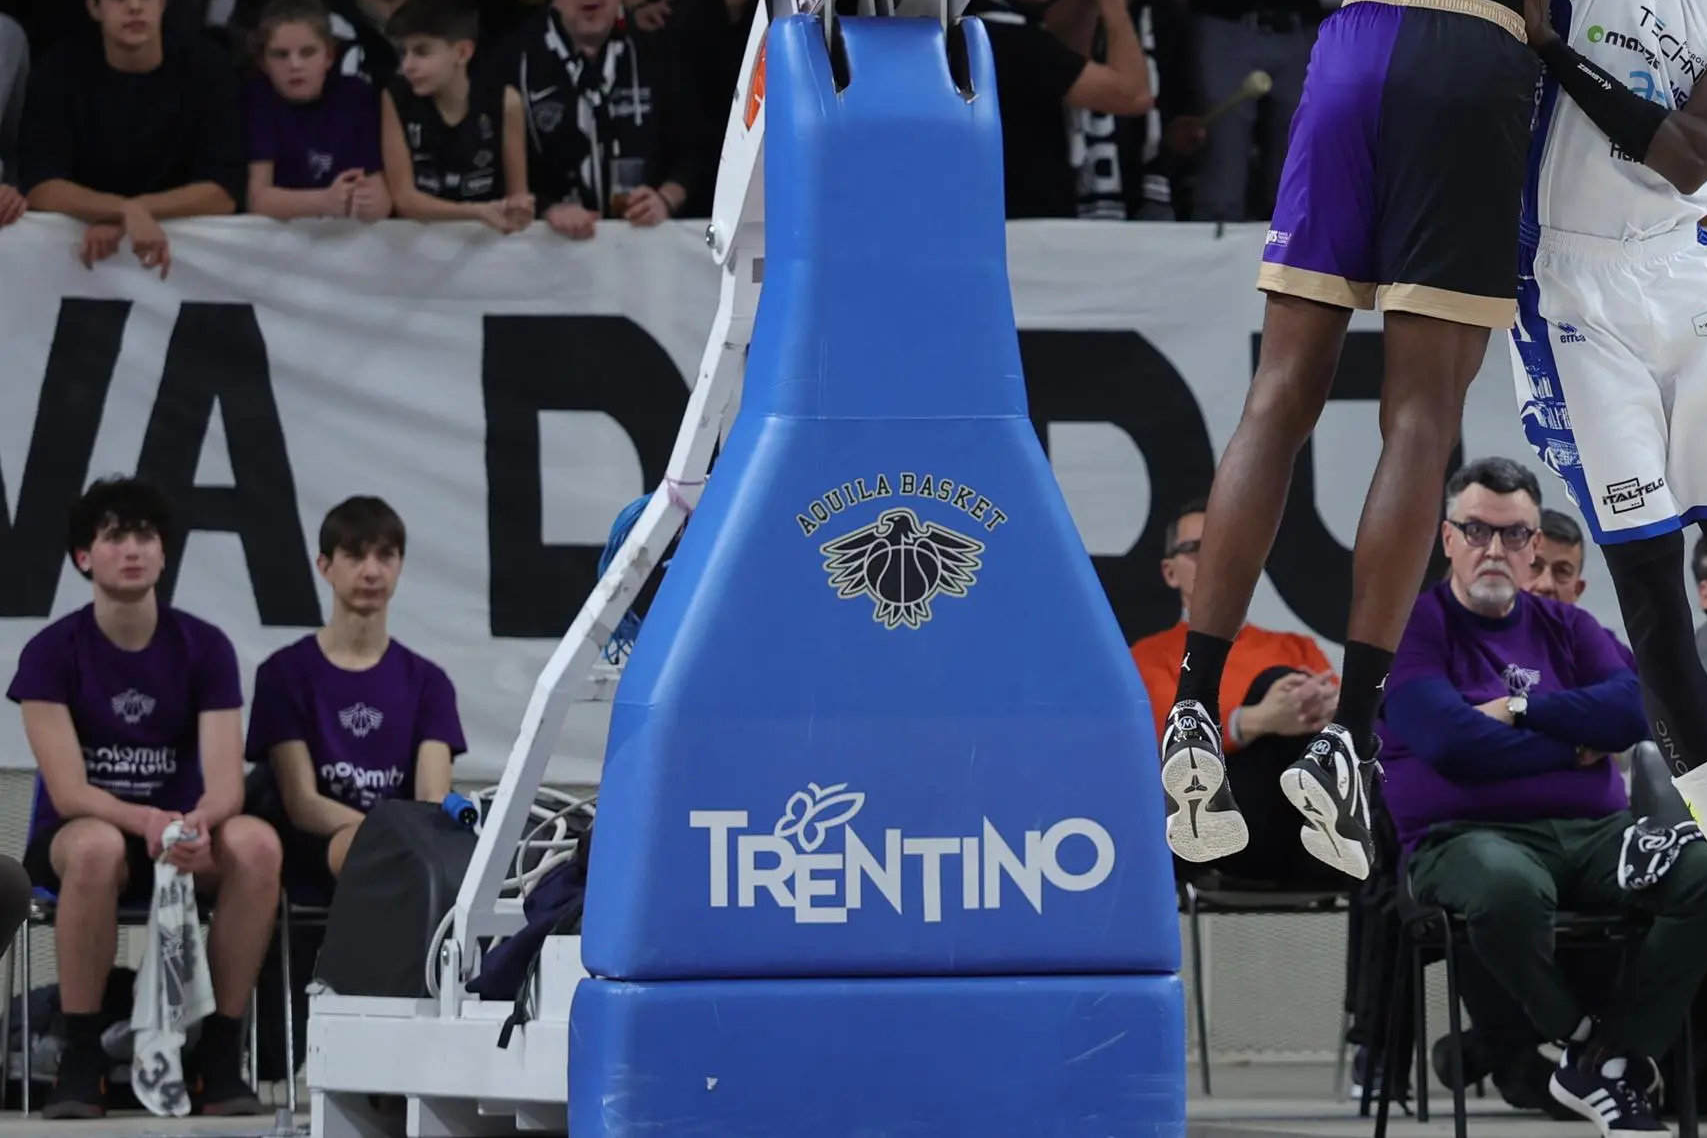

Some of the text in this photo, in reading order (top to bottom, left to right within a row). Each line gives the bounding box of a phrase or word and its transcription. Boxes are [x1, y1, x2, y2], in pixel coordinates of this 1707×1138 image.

[797, 471, 1008, 535] AQUILA BASKET
[688, 810, 1117, 926] TRENTINO
